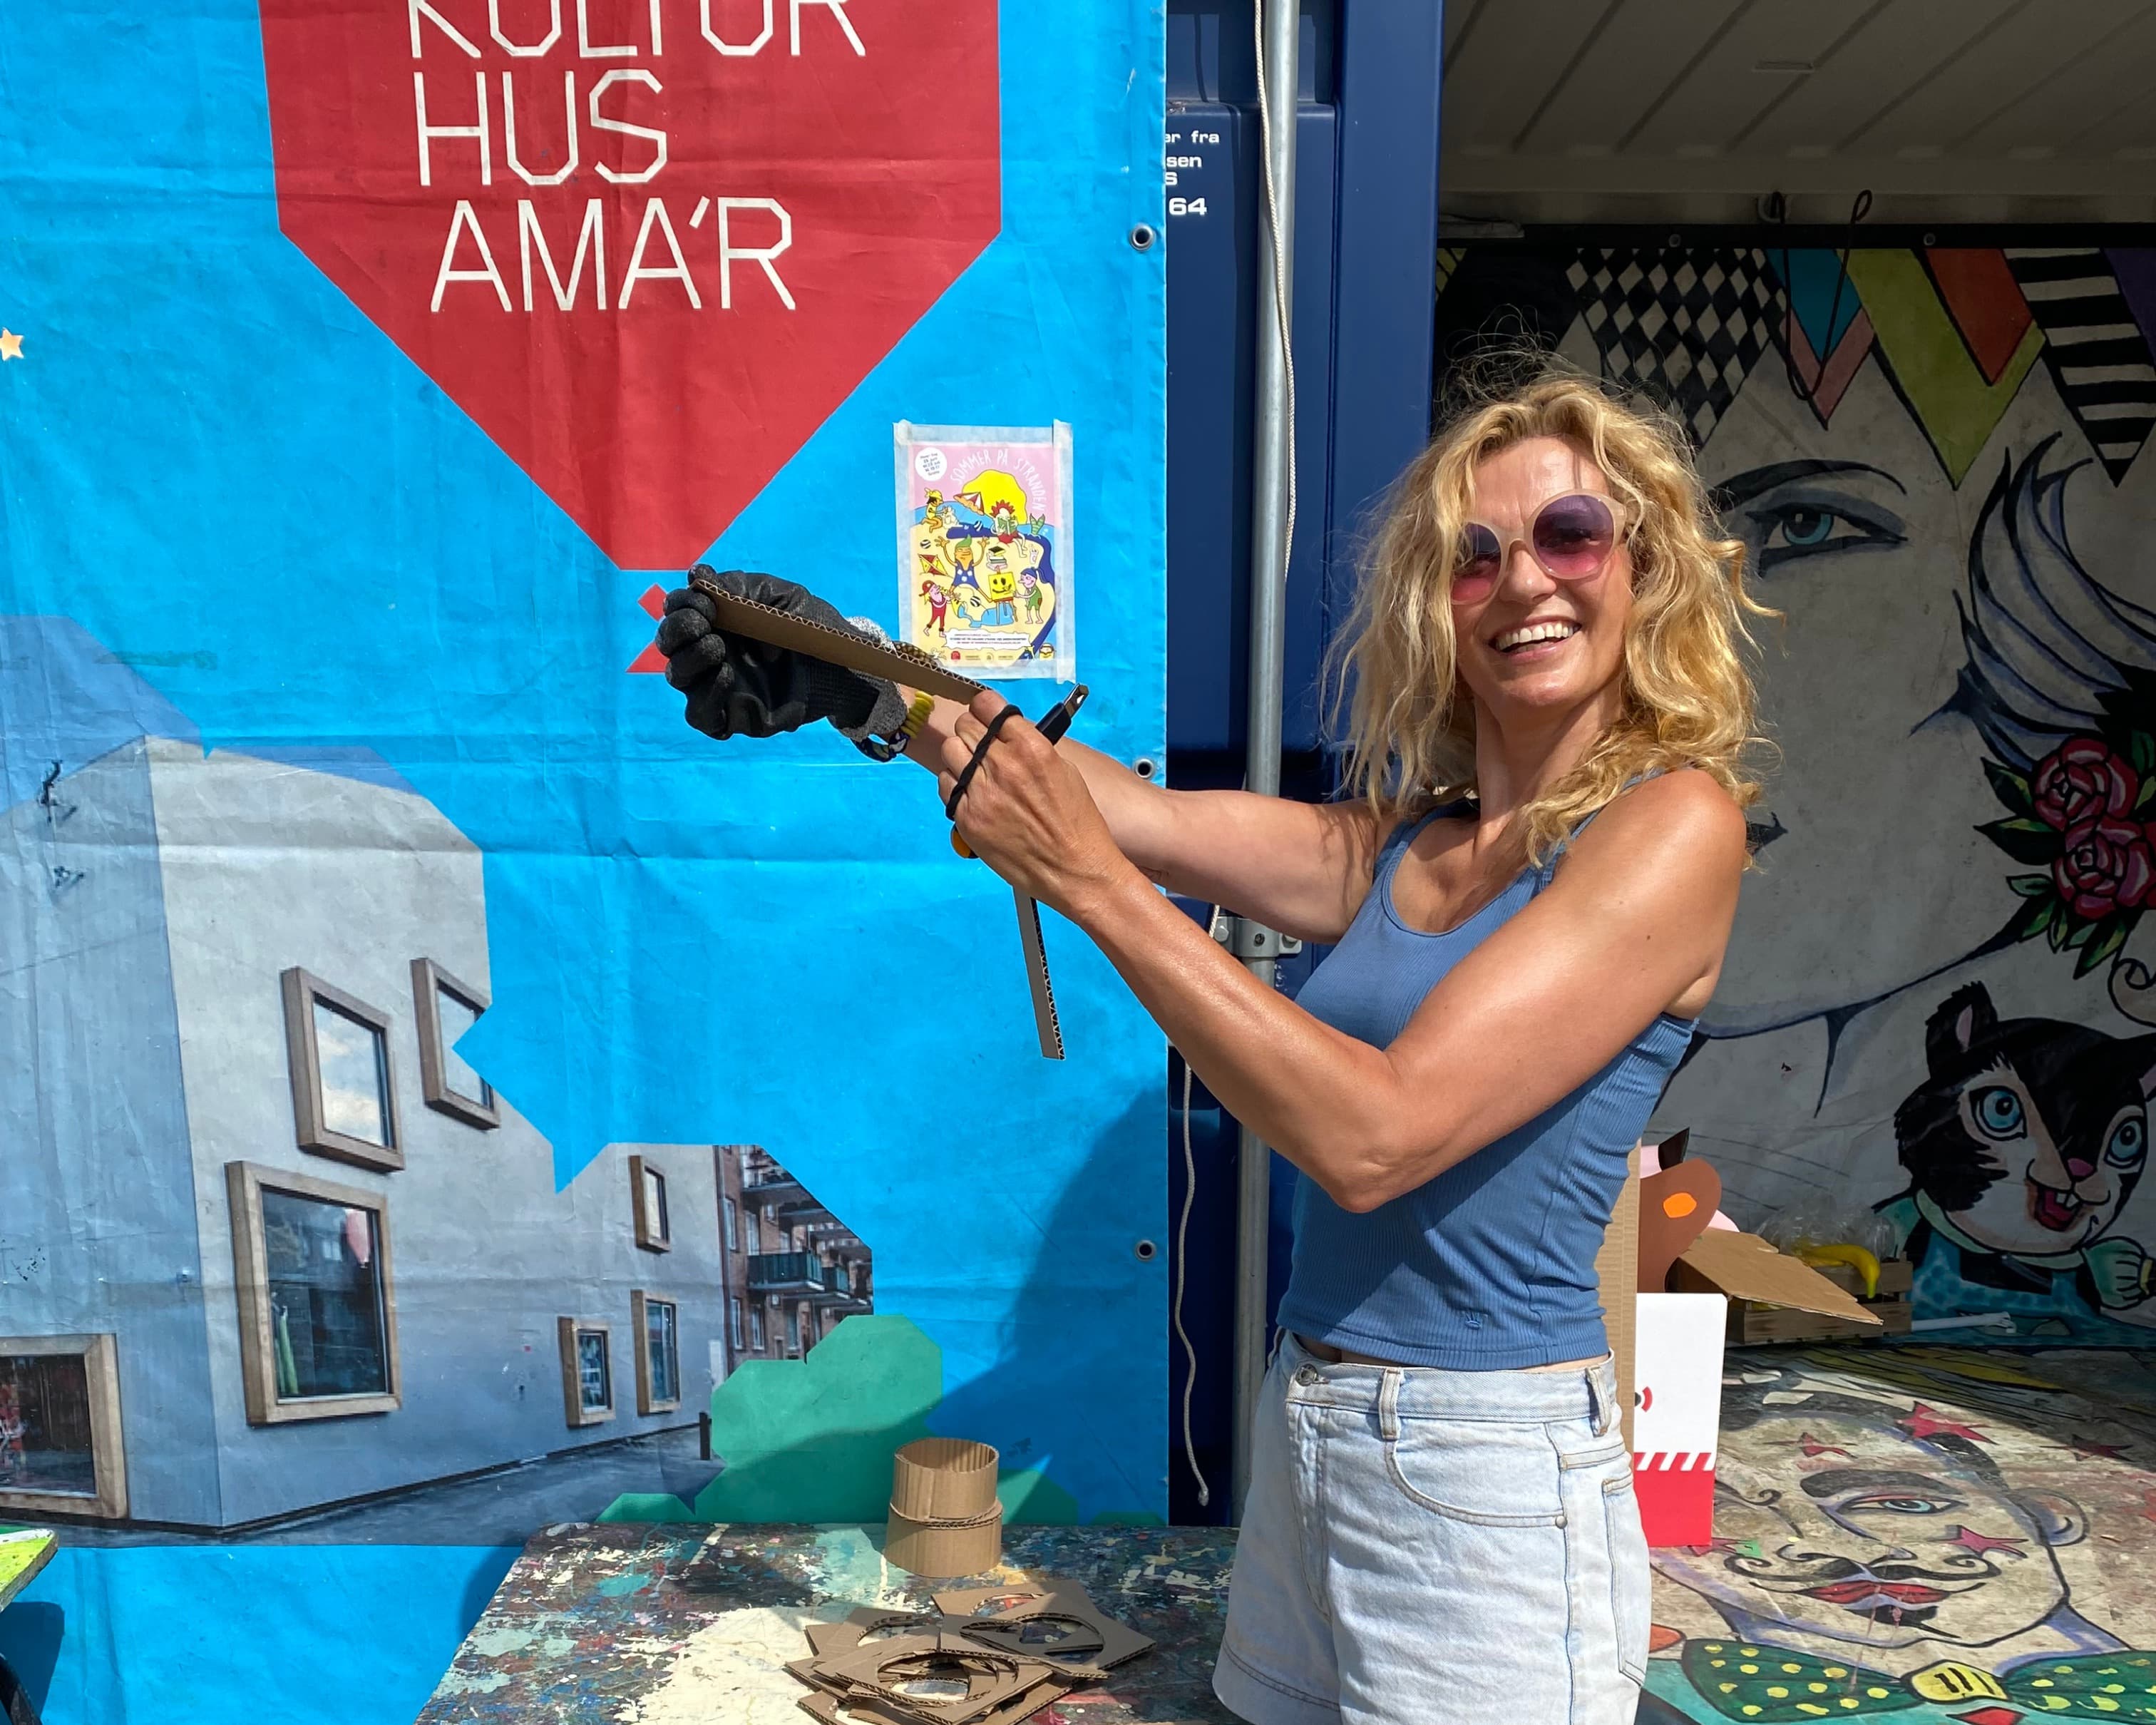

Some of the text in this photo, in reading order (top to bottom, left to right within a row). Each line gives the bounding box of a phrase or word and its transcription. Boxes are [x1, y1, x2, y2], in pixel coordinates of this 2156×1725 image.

[414, 69, 667, 186] HUS
[1191, 130, 1220, 143] fra
[1166, 155, 1202, 168] sen
[1169, 197, 1207, 215] 64
[950, 449, 992, 484] SOMMER
[1014, 458, 1047, 511] STRANDEN
